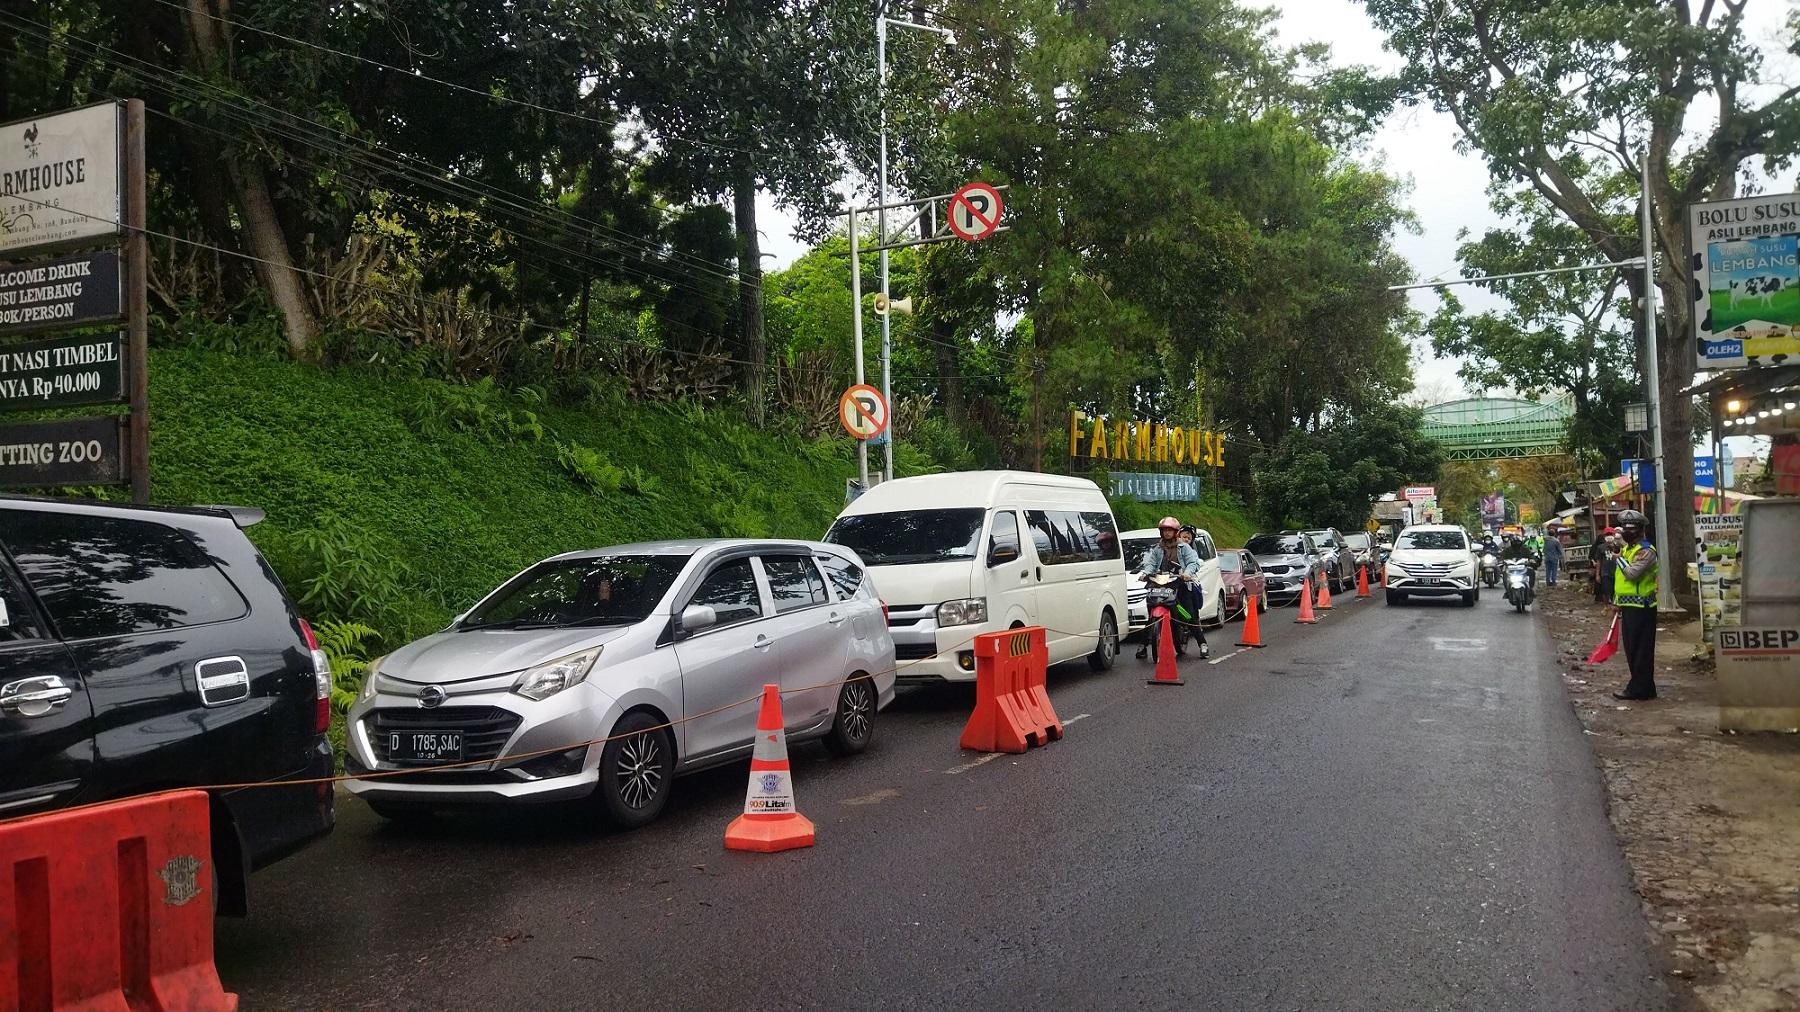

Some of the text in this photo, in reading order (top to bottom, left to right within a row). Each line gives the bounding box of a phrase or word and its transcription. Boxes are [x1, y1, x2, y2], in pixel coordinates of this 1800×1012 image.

[0, 158, 85, 196] RMHOUSE
[3, 198, 60, 216] LEMBANG
[1699, 201, 1800, 227] BOLU SUSU
[1708, 221, 1796, 240] ASLI LEMBANG
[48, 261, 91, 281] DRINK
[1711, 254, 1796, 273] LEMBANG
[19, 281, 82, 304] LEMBANG
[13, 349, 50, 372] NASI
[53, 342, 117, 367] TIMBEL
[1707, 345, 1741, 355] OLEH2
[32, 377, 53, 400] Rp
[54, 371, 101, 394] 40.000
[1070, 410, 1226, 467] FARMHOUSE
[59, 440, 102, 463] ZOO
[1695, 516, 1720, 524] BOLU
[391, 734, 460, 751] D 1785 SAC
[749, 800, 766, 808] 90.9
